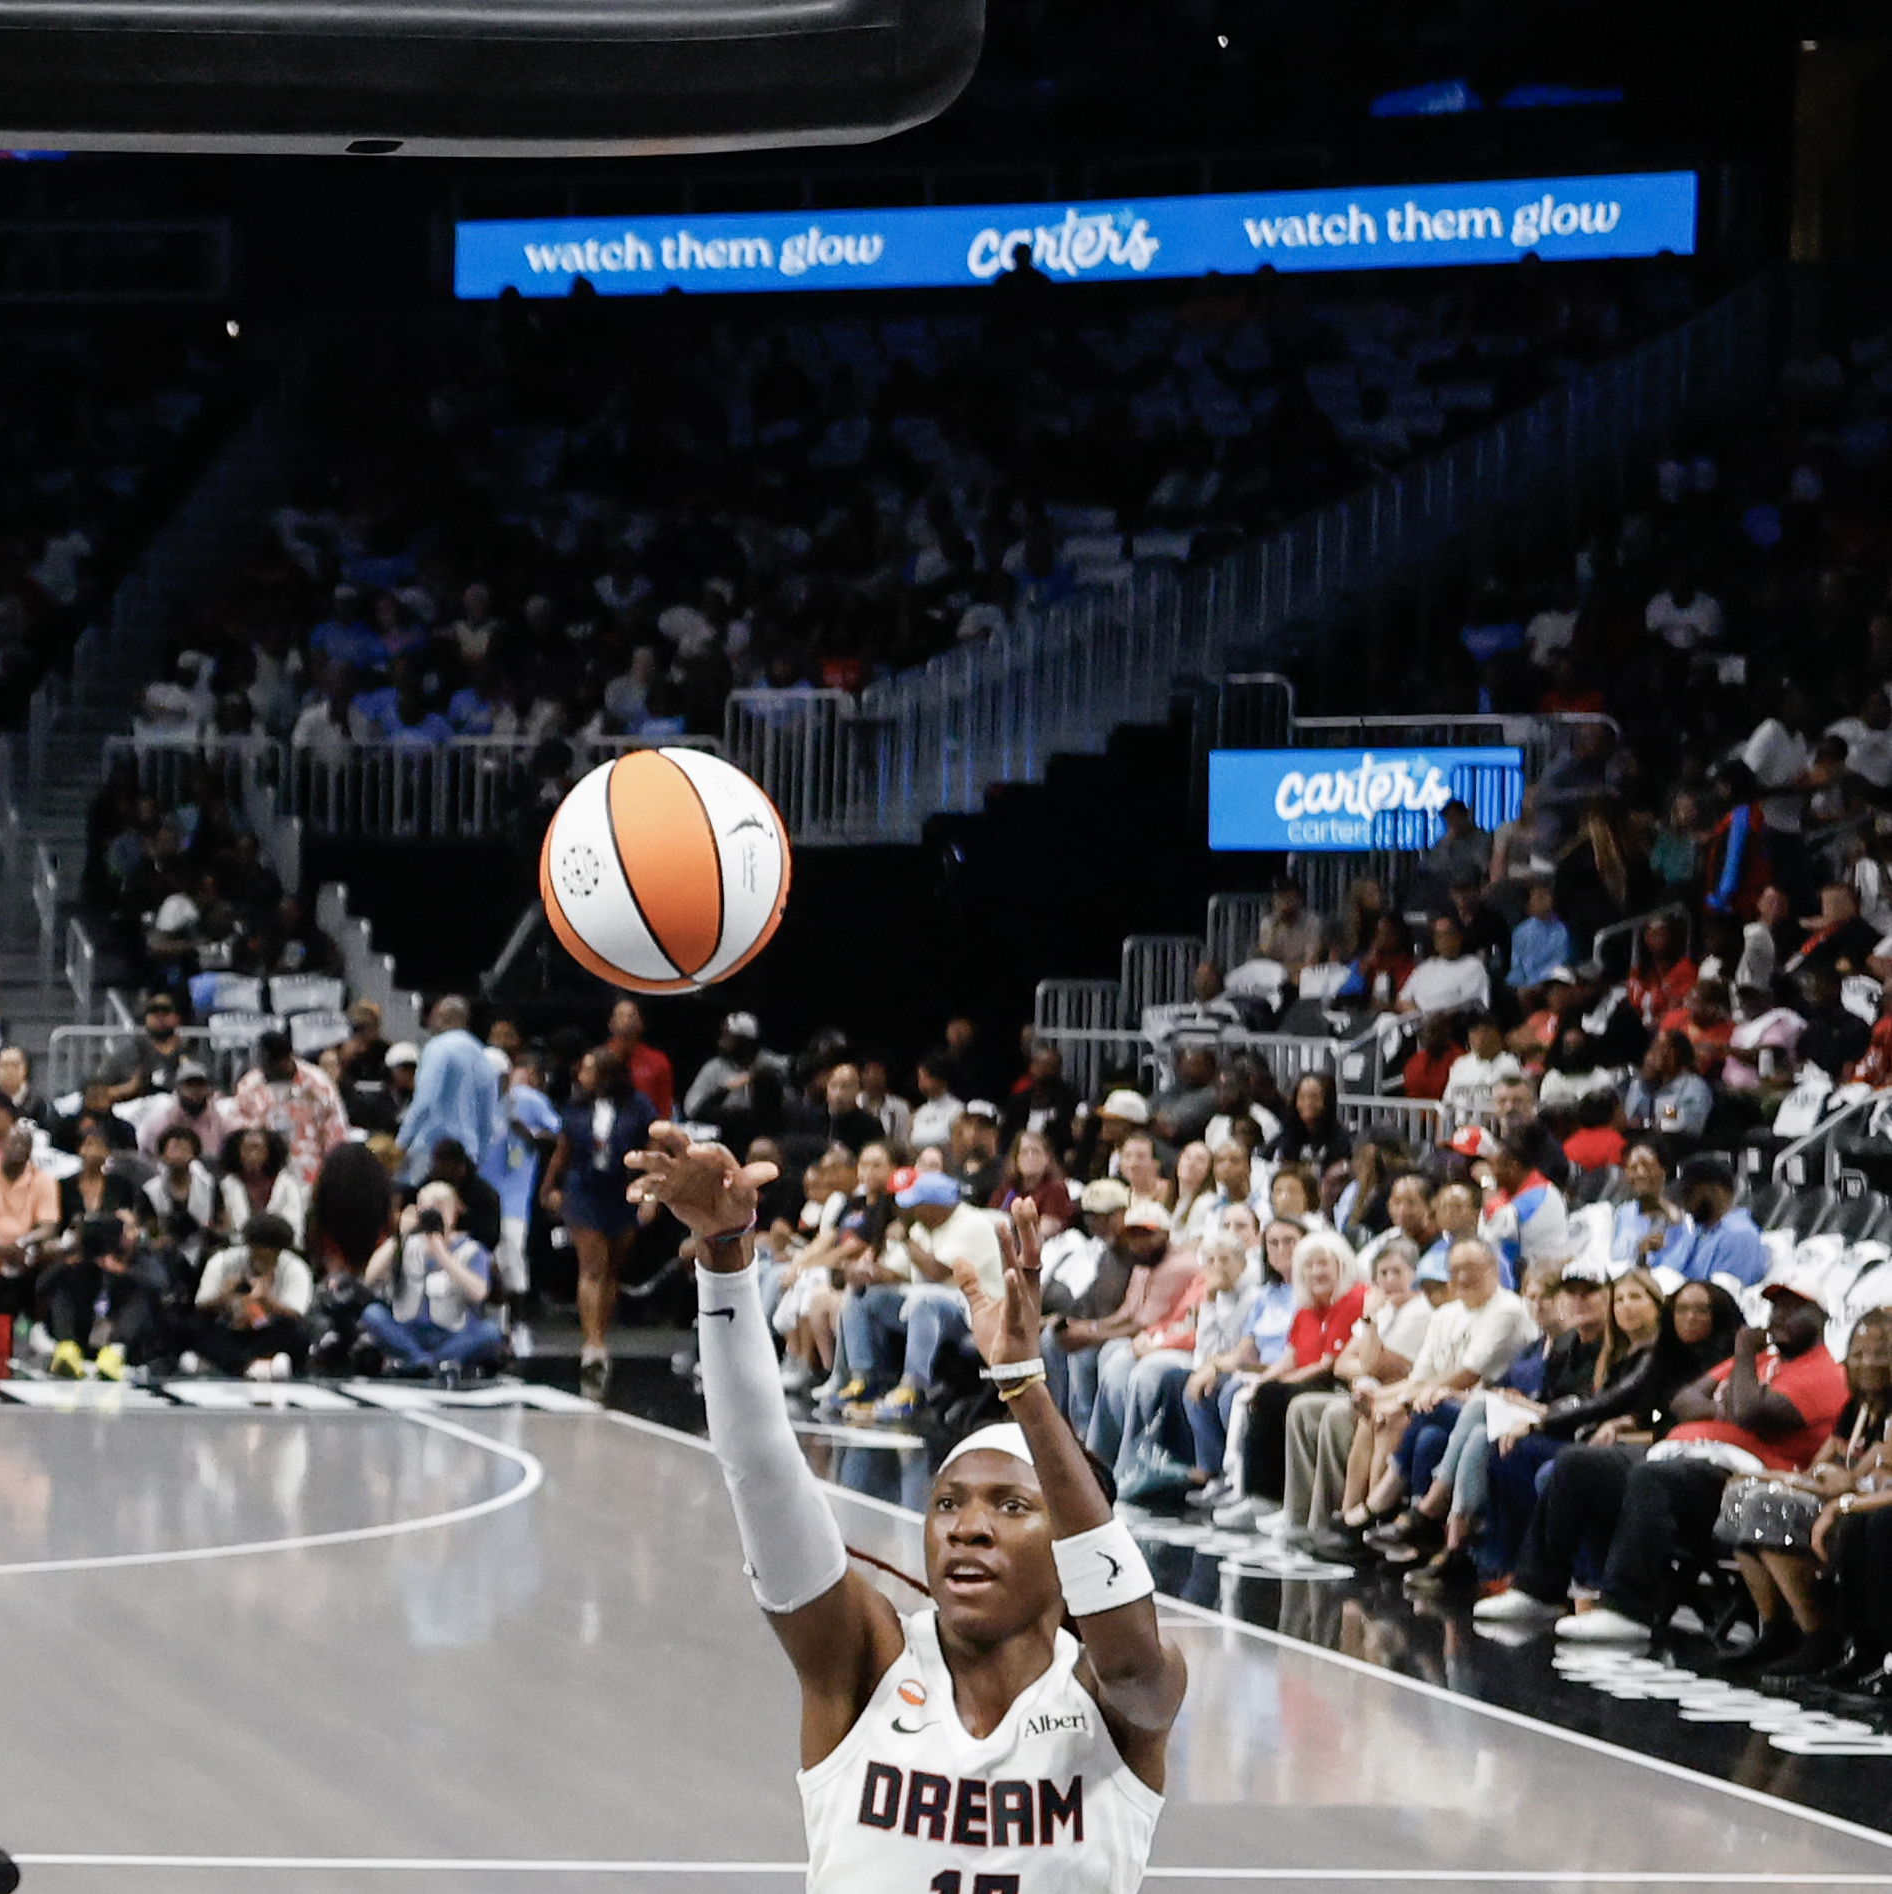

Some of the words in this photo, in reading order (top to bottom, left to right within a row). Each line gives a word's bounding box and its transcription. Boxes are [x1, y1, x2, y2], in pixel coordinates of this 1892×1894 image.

[1243, 204, 1377, 248] watch
[1385, 201, 1503, 243] them
[1511, 194, 1620, 247] glow
[525, 231, 652, 274] watch
[660, 230, 773, 270] them
[779, 226, 884, 277] glow
[1024, 1712, 1089, 1738] Albert
[858, 1760, 1083, 1847] DREAM
